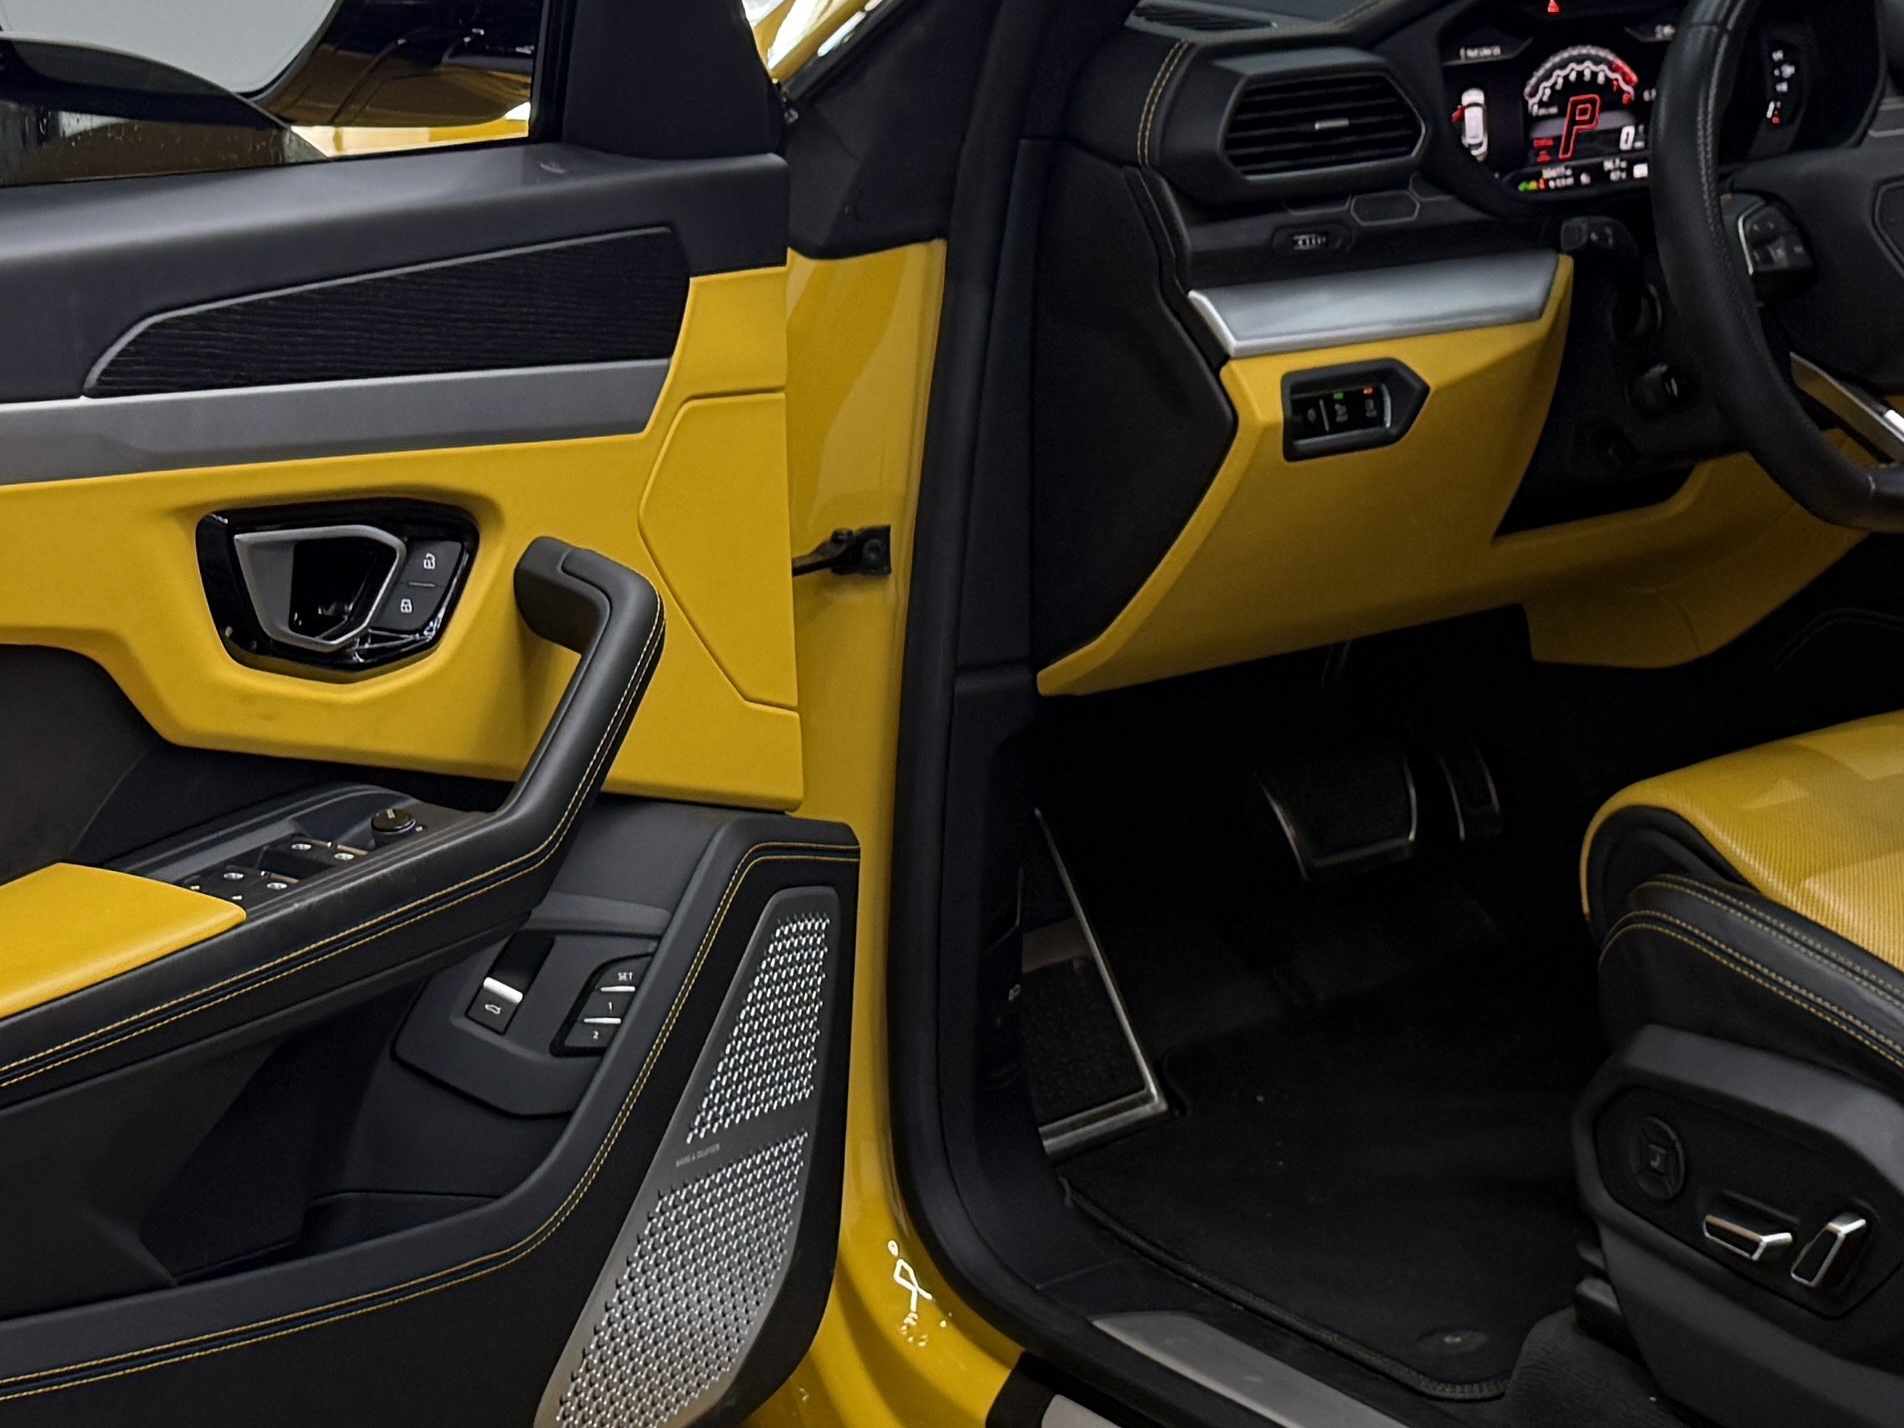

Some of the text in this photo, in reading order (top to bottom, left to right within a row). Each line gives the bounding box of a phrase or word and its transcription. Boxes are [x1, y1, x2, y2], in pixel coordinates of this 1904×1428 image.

[1558, 93, 1601, 159] P
[1619, 125, 1636, 151] 0
[617, 972, 633, 981] SET
[593, 1030, 599, 1040] 2
